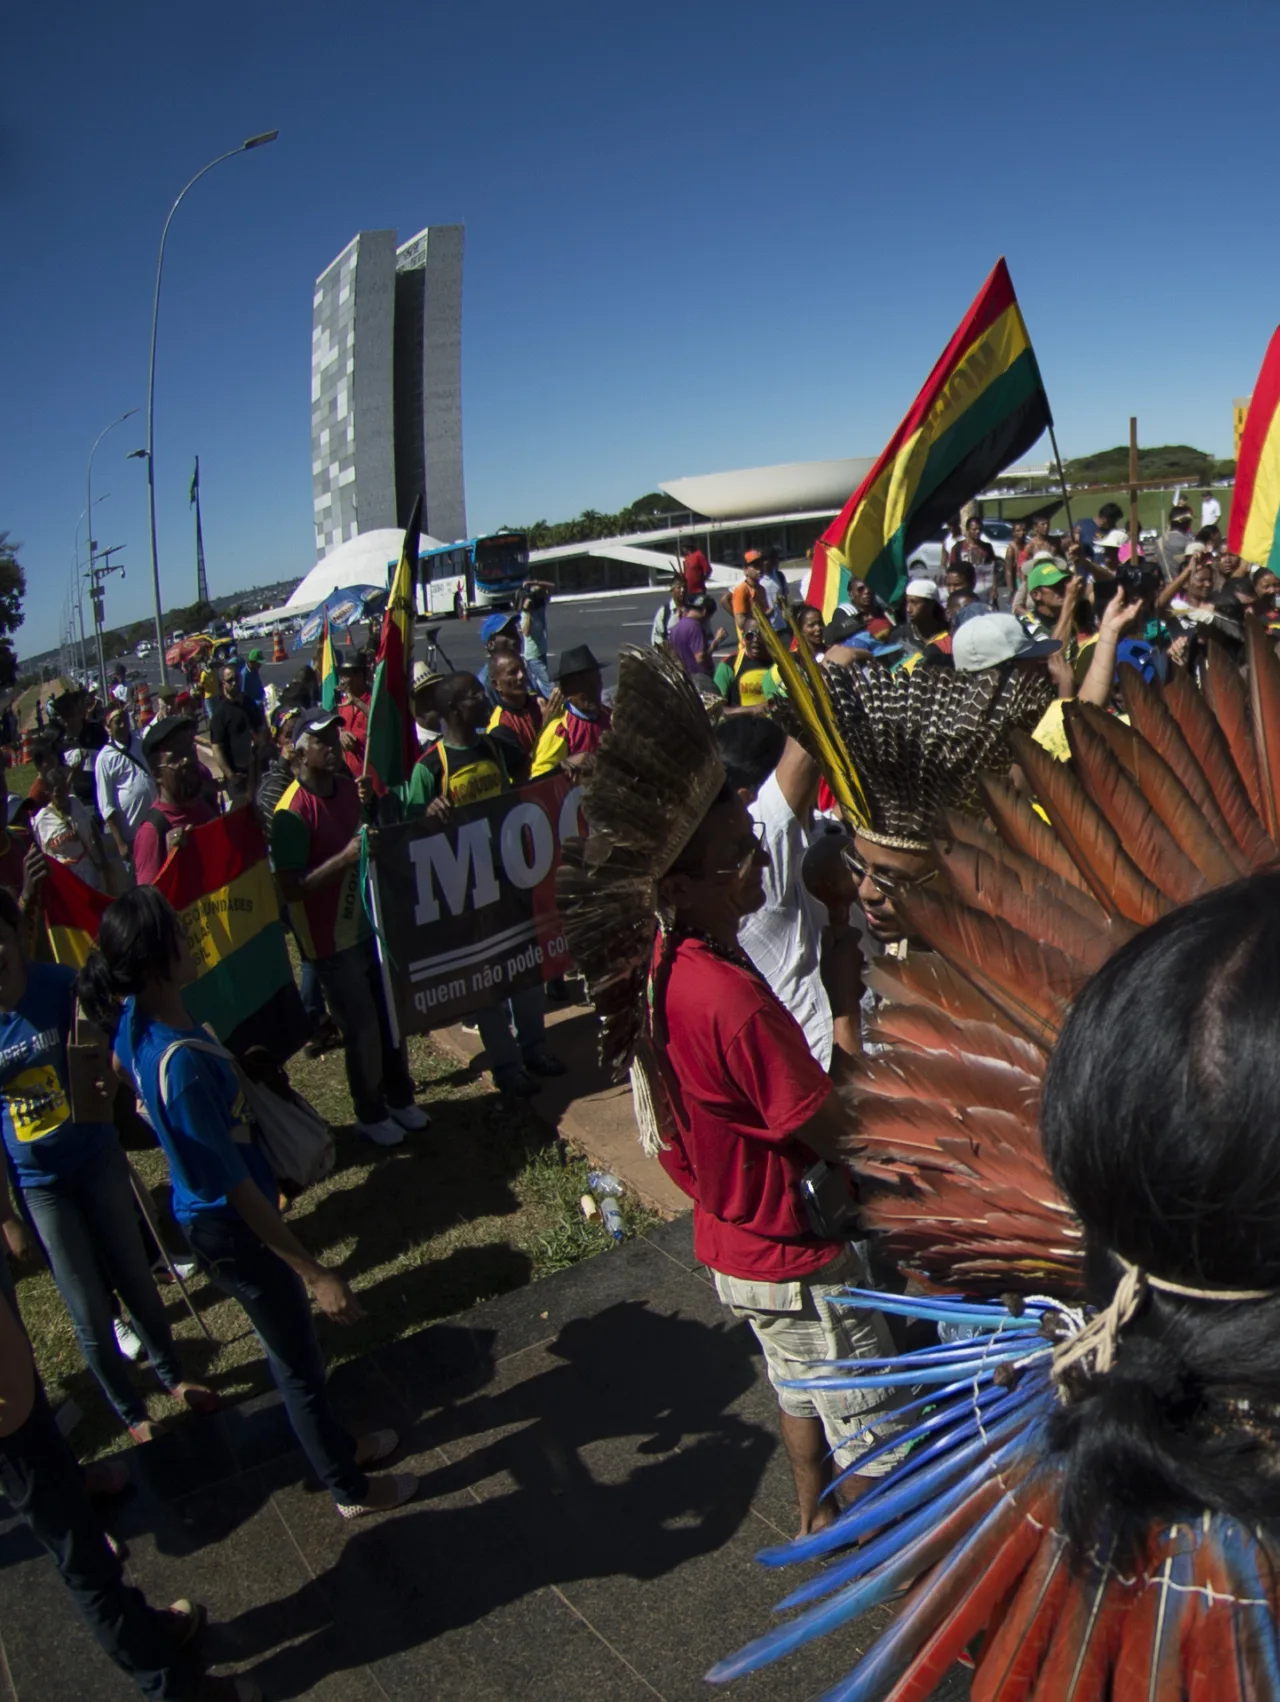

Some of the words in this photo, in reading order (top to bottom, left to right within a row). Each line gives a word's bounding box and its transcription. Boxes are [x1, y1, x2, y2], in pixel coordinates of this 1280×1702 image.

[414, 980, 467, 1013] quem
[472, 964, 501, 992] não
[506, 945, 544, 982] pode
